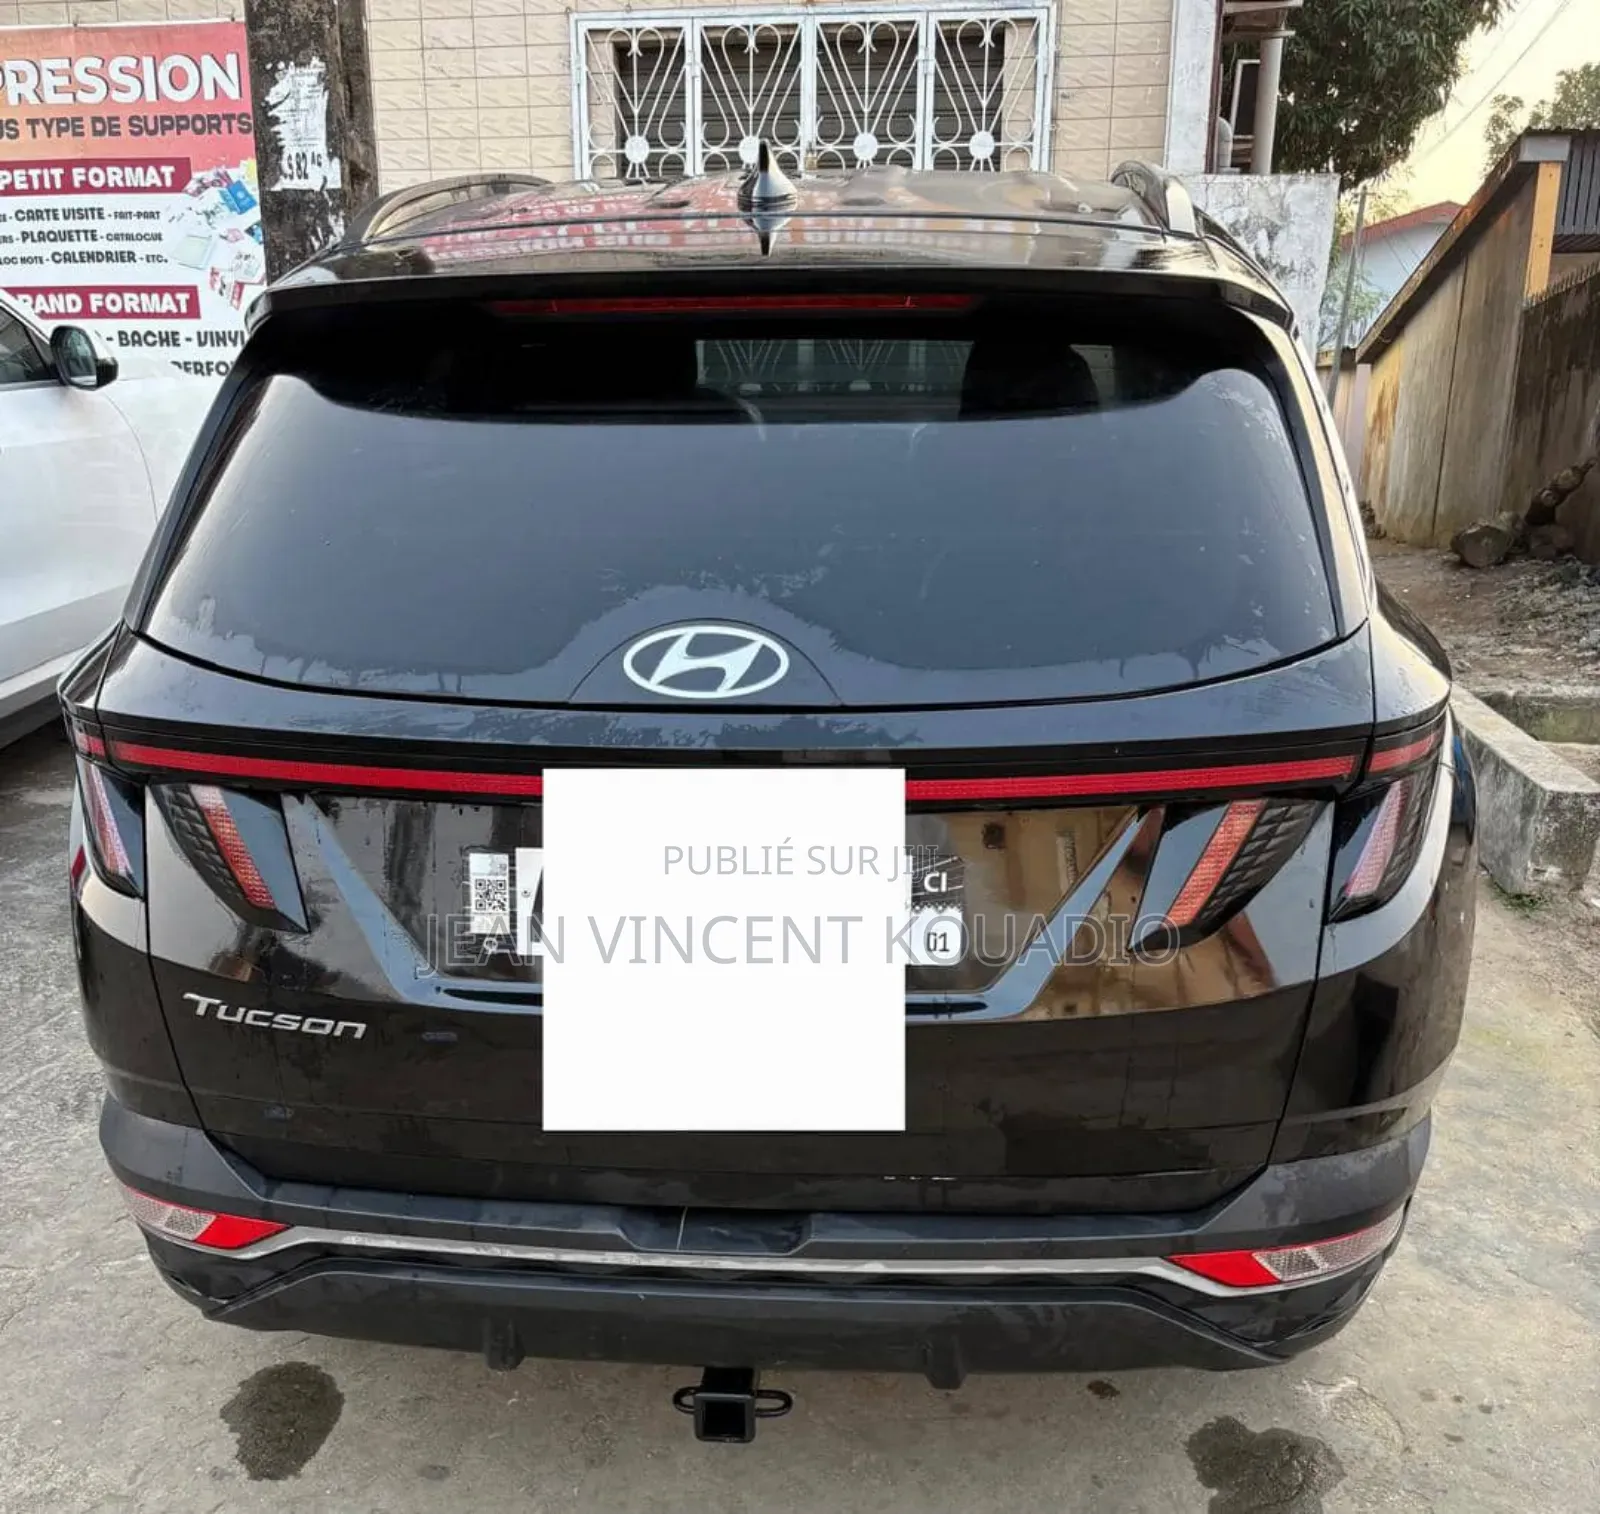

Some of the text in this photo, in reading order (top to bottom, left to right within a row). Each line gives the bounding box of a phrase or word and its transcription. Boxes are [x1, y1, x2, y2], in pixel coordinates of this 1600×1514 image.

[0, 53, 242, 106] RESSION
[26, 117, 86, 139] TYPE
[91, 115, 122, 137] DE
[128, 112, 253, 137] SUPPORTS
[0, 165, 176, 191] PETIT FORMAT
[14, 208, 60, 222] CARTE
[62, 206, 105, 221] VISITE
[21, 228, 98, 243] PLAQUETTE
[106, 232, 163, 242] CATALOGUE
[20, 255, 44, 265] NOTE
[51, 249, 137, 265] CALENDRIER
[15, 291, 190, 314] RAND FORMAT
[118, 329, 181, 348] BACHE
[923, 871, 948, 893] CI
